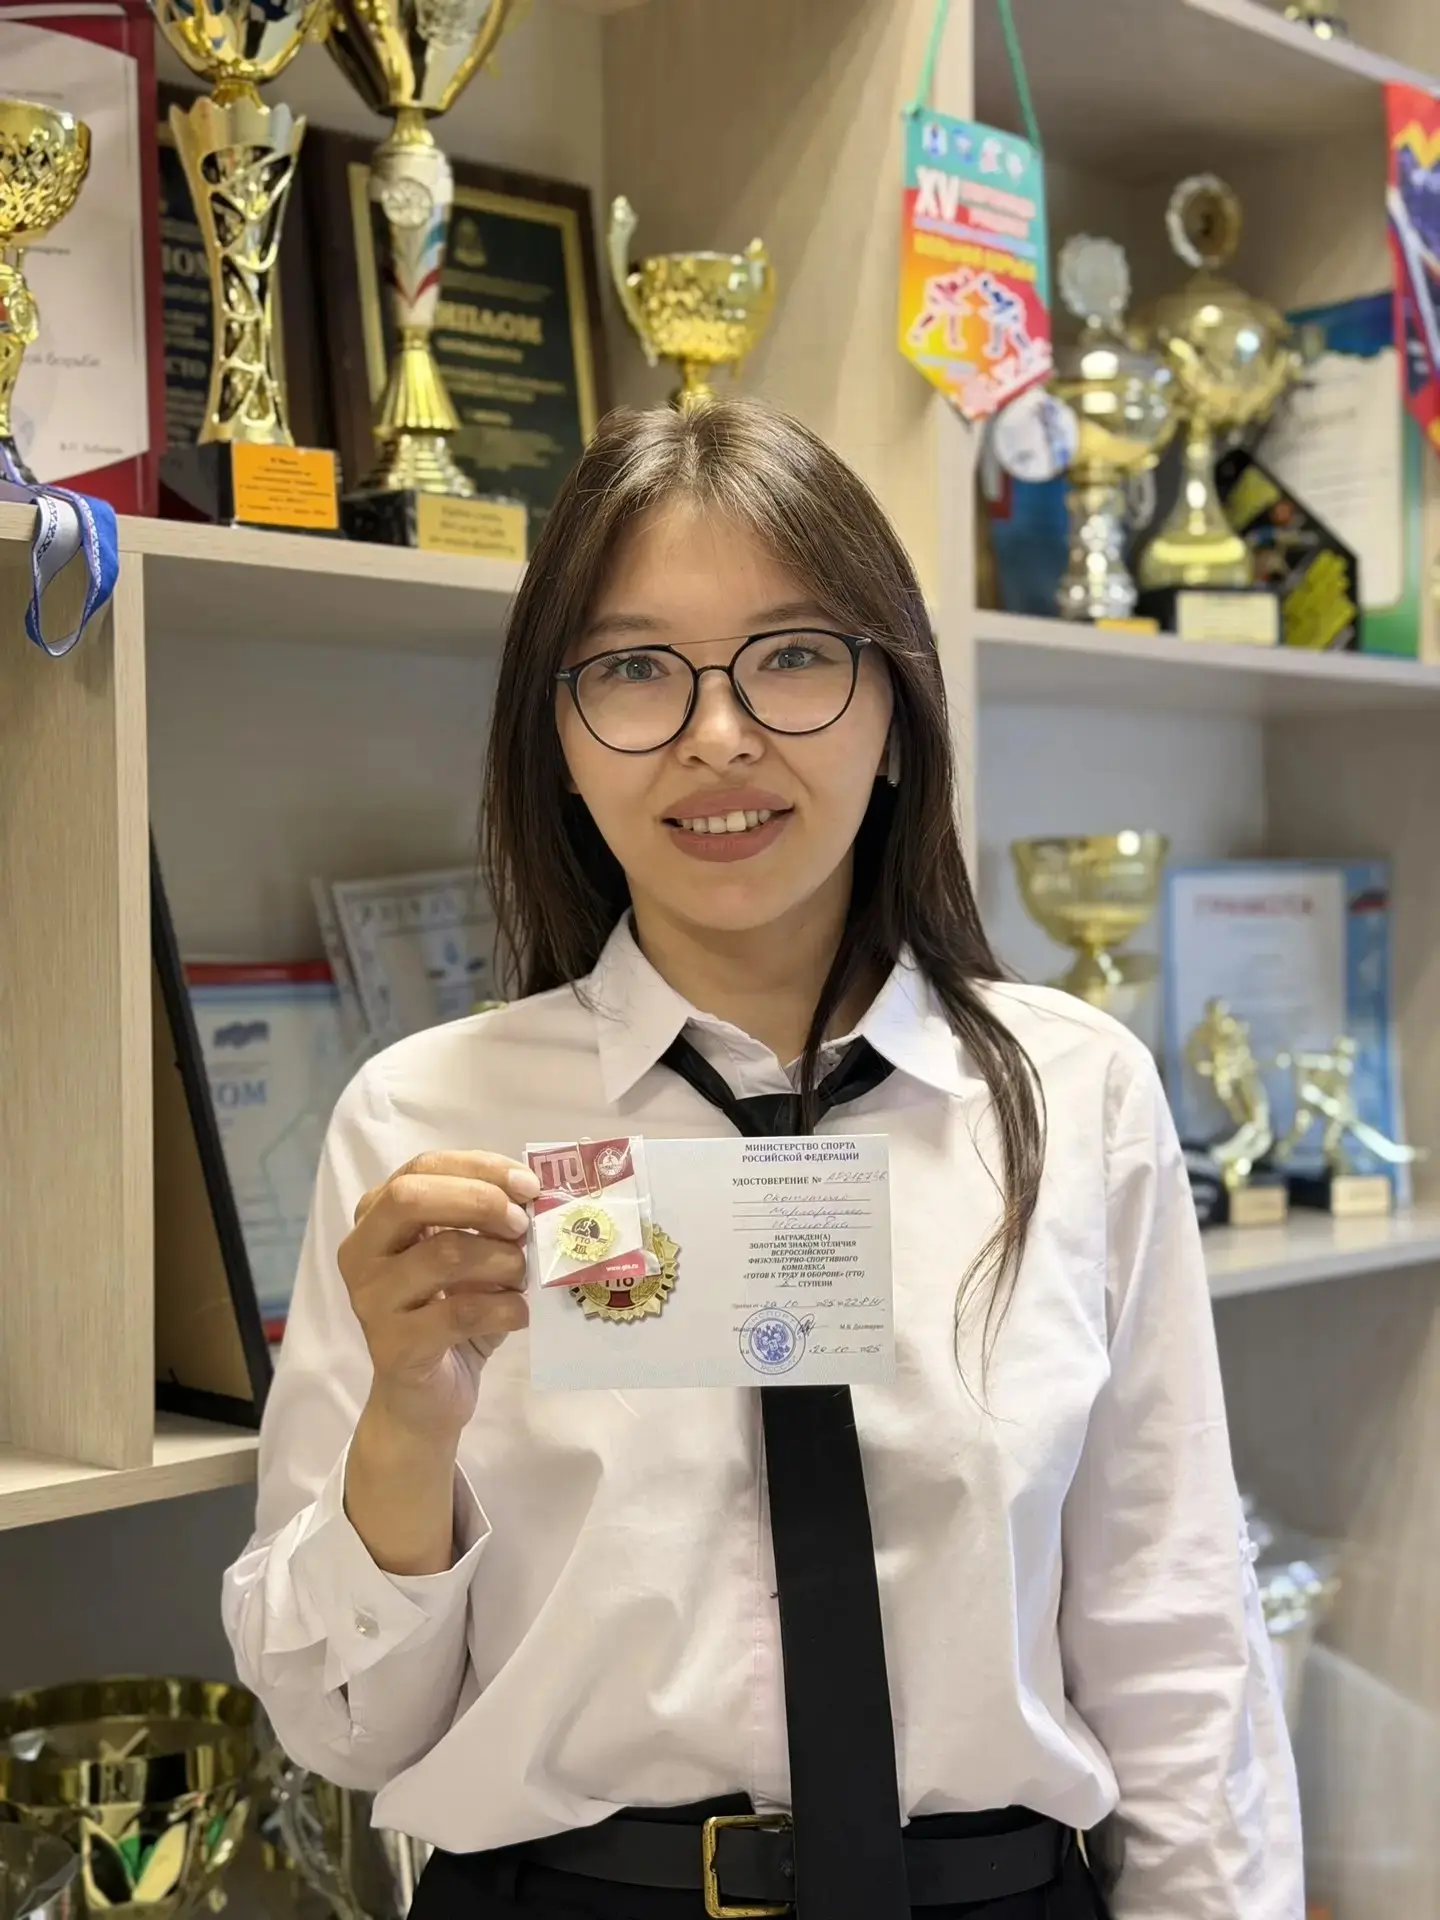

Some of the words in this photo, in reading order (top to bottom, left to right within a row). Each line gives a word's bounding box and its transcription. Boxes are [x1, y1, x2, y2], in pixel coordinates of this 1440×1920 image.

[436, 301, 543, 345] ИПЛОМ
[745, 1142, 819, 1152] МИНИСТЕРСТВО
[820, 1141, 856, 1150] СПОРТА
[742, 1151, 802, 1163] РОССИЙСКОЙ
[804, 1152, 860, 1163] ФЕДЕРАЦИИ
[533, 1152, 585, 1189] ГТО
[731, 1177, 809, 1187] УДОСТОВЕРЕНИЕ
[575, 1235, 591, 1244] ГТО
[820, 1240, 857, 1248] ОТЛИЧИЯ
[770, 1248, 836, 1256] ВСЕРОССИЙСКОГО
[748, 1255, 859, 1264] ФИЗКУЛЬТУРНО-СПОРТИВНОГО
[845, 1270, 865, 1278] (ГТО)
[798, 1280, 833, 1288] СТУПЕНИ
